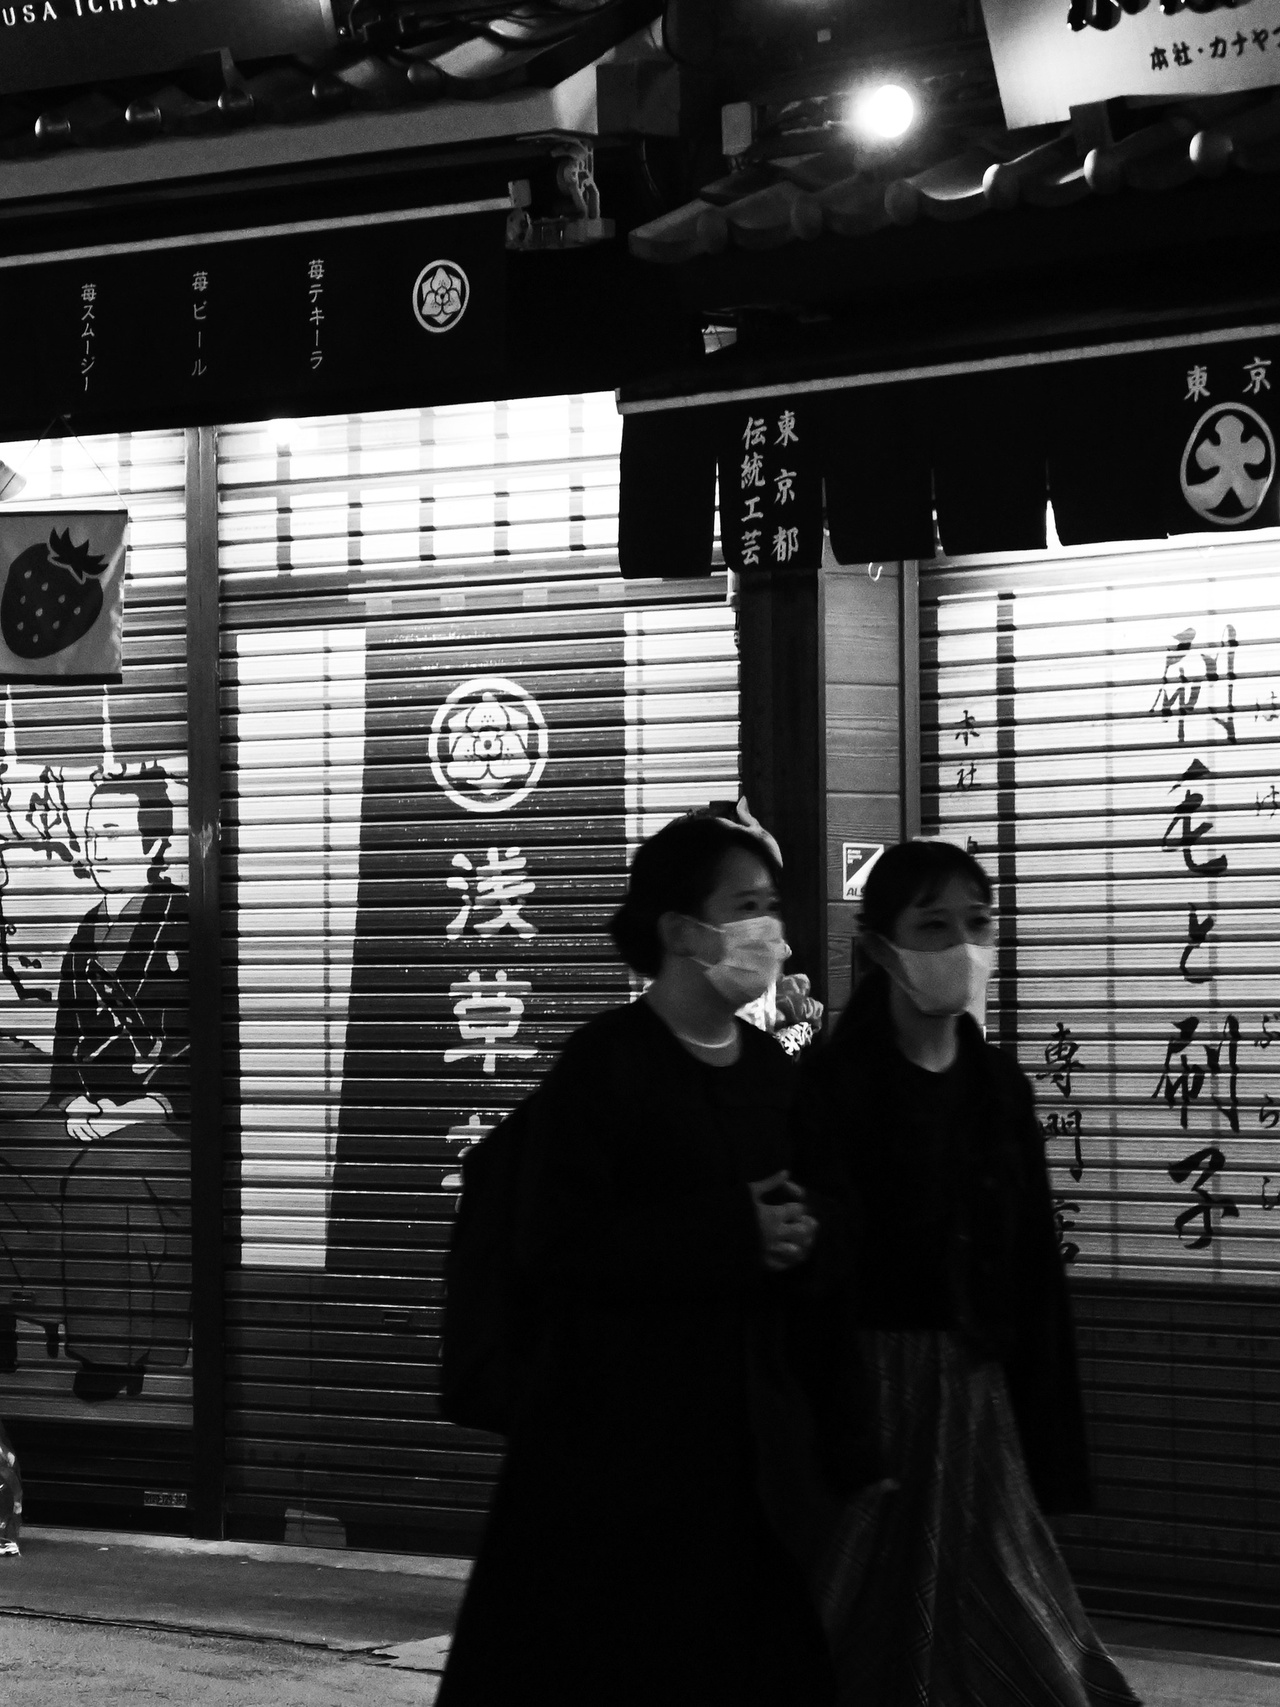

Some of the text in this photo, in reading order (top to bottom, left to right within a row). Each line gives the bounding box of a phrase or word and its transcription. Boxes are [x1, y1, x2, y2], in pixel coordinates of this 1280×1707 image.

[75, 0, 177, 17] ICH
[80, 283, 97, 392] 苺スムージー
[191, 271, 209, 377] 苺ビール
[308, 259, 325, 370] 苺テキーラ
[1184, 356, 1272, 402] 東京
[740, 416, 767, 566] 伝統工芸
[771, 410, 799, 562] 東京都
